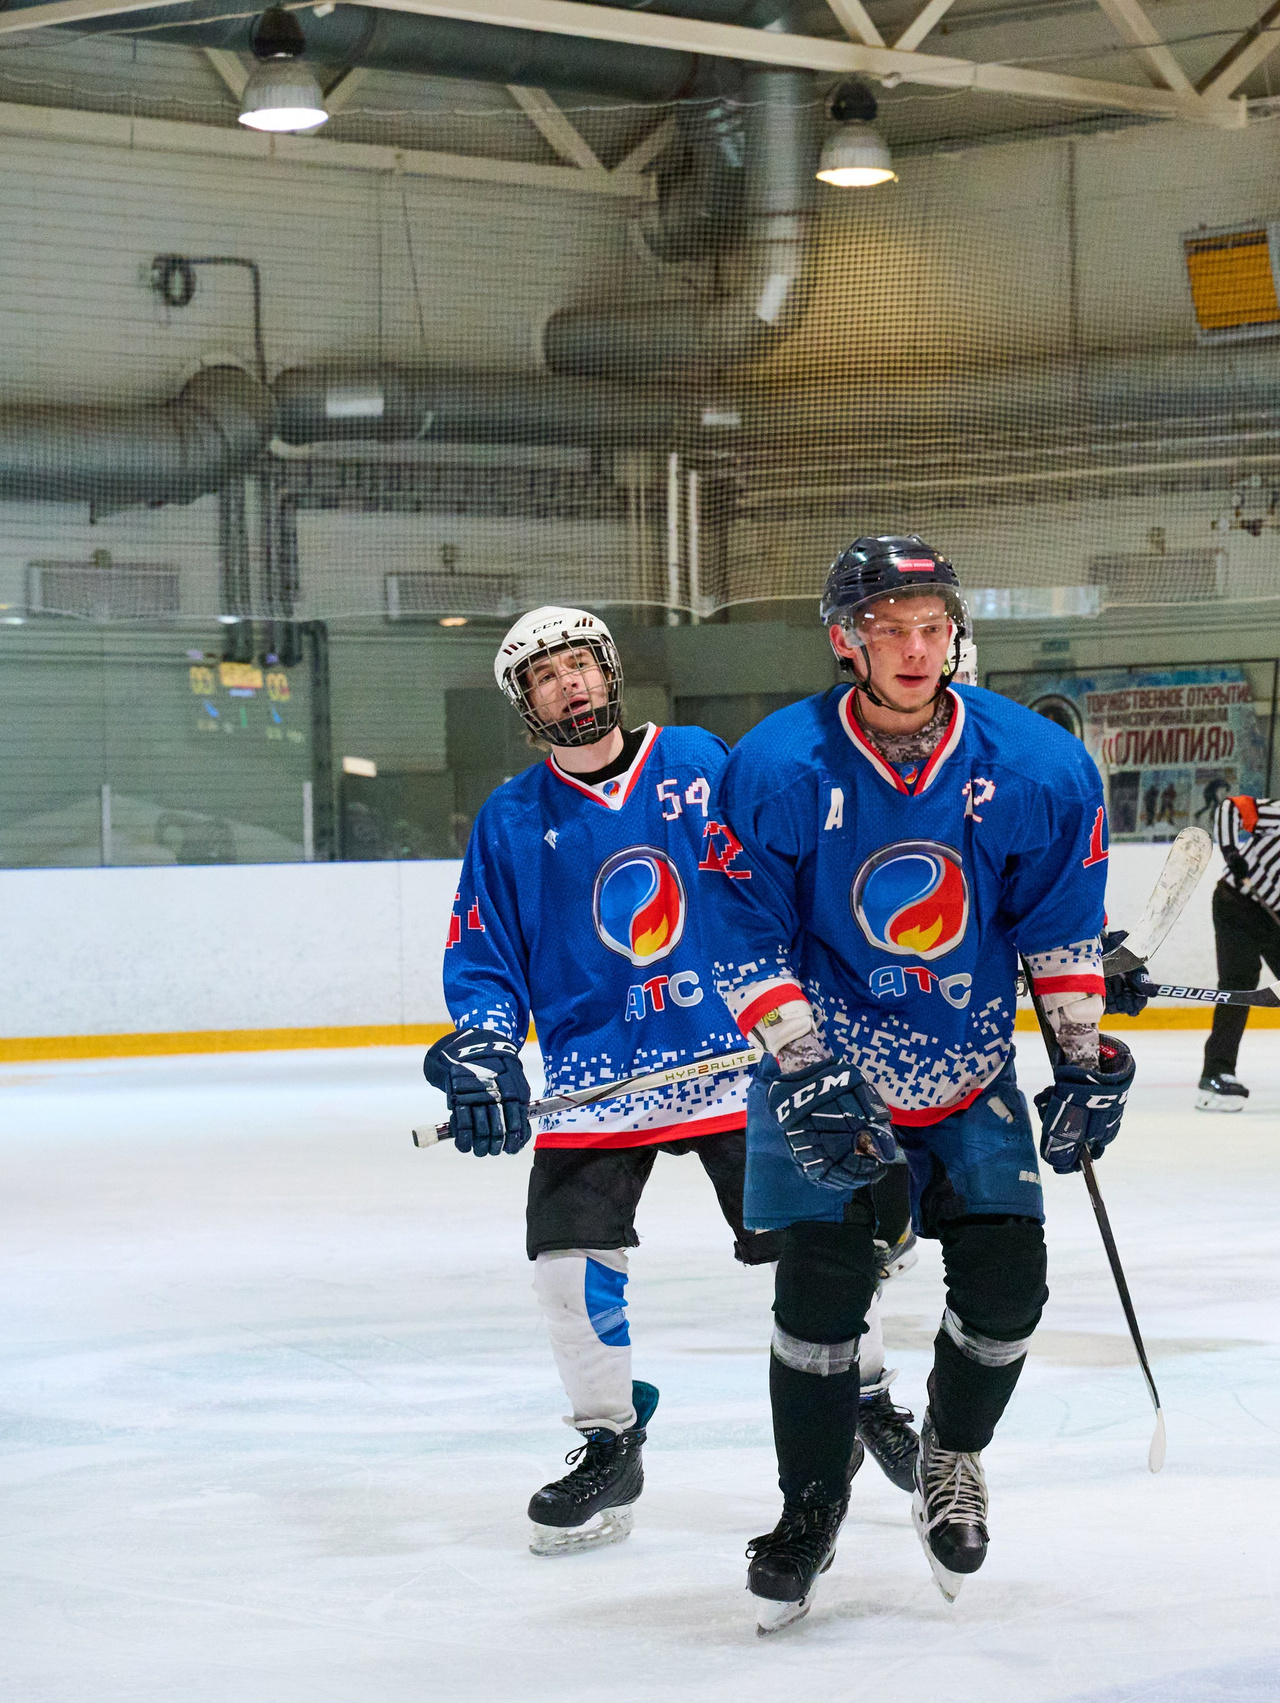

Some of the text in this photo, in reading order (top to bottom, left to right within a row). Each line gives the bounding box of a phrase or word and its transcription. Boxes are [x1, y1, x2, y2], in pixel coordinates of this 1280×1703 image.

[533, 620, 563, 634] CCM
[656, 778, 710, 821] 54
[1157, 984, 1231, 1003] BAUER
[458, 1042, 518, 1058] CC
[665, 1053, 757, 1081] HYP2RLITE
[776, 1071, 851, 1123] CCM
